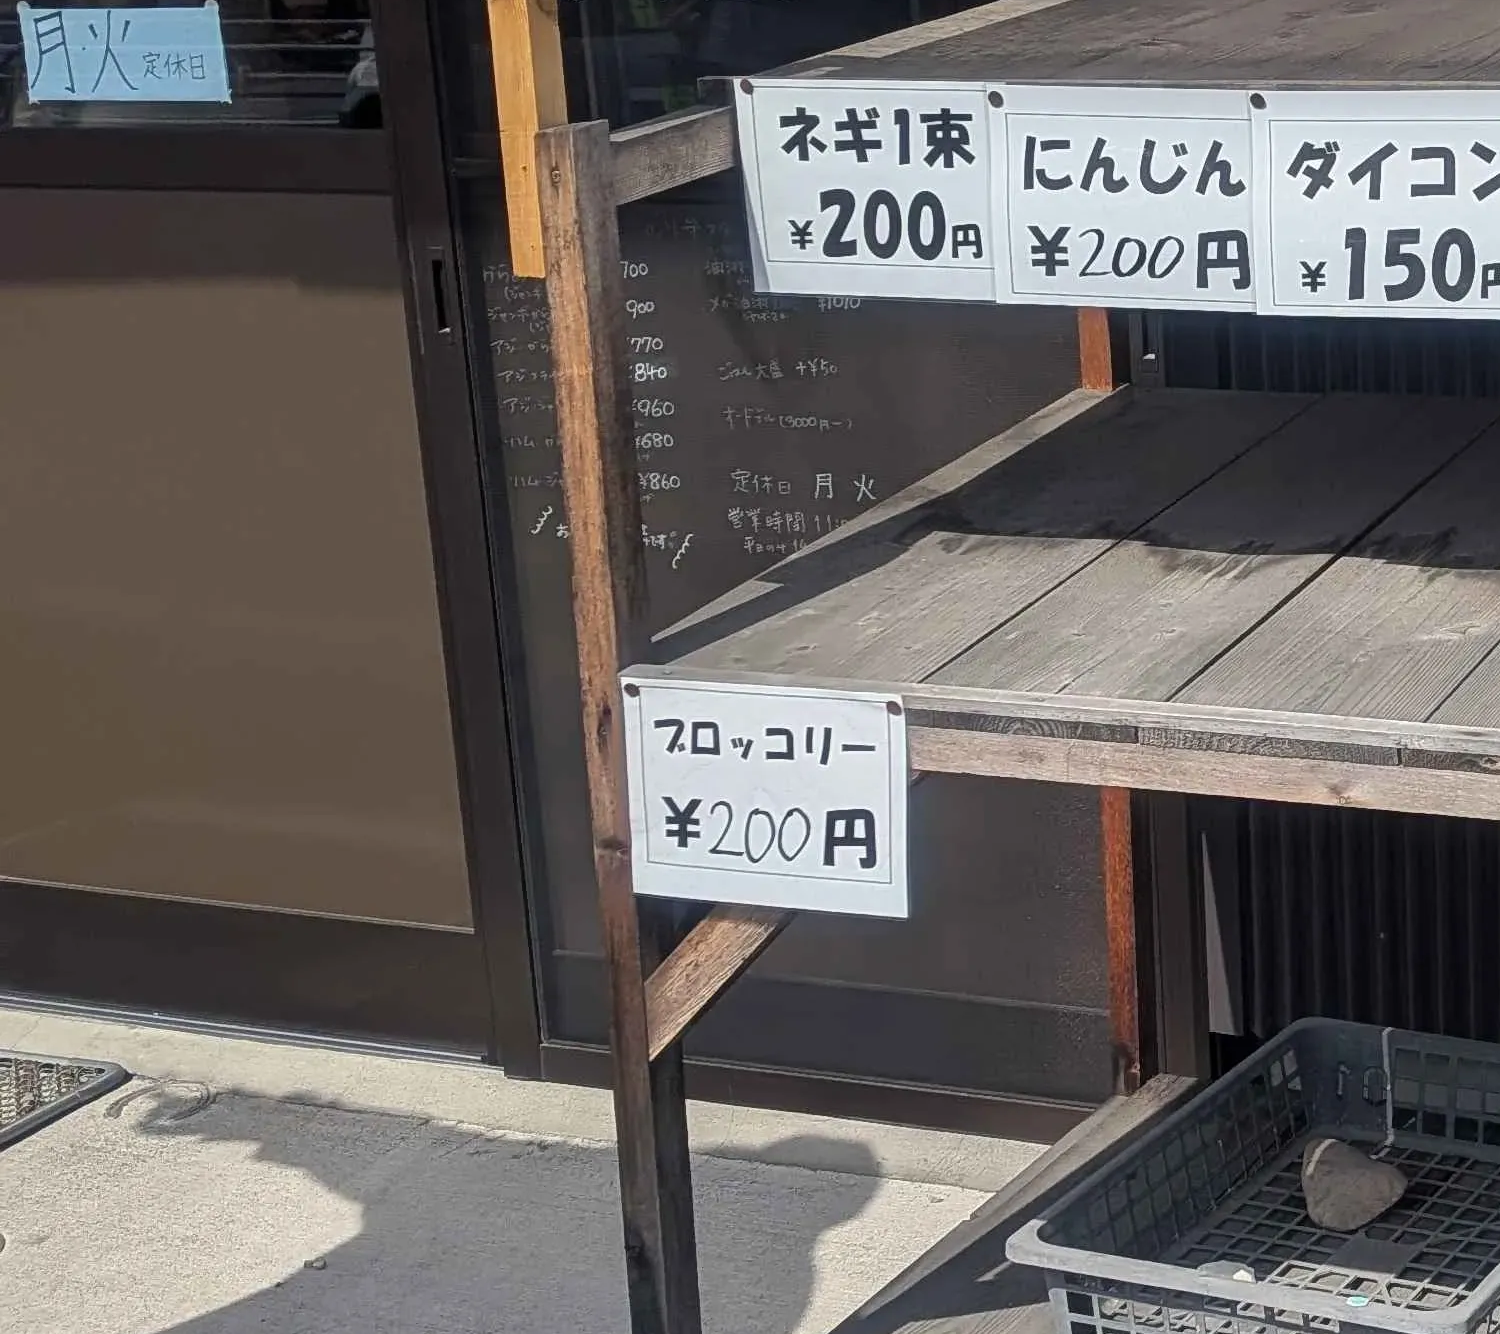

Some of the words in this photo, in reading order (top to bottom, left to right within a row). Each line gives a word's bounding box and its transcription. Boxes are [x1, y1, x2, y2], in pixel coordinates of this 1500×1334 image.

[142, 52, 206, 80] 定休日
[779, 107, 976, 168] ネギ1束
[1023, 135, 1247, 197] にんじん
[788, 188, 984, 261] ¥200円
[1030, 225, 1251, 291] ¥200円
[626, 337, 664, 353] 770
[629, 363, 667, 381] 840
[730, 469, 791, 495] 定休日
[814, 473, 833, 499] 月
[853, 474, 877, 502] 火
[728, 506, 806, 534] 営業時間
[654, 719, 876, 766] ブロッコリー
[661, 796, 878, 870] ¥200円
